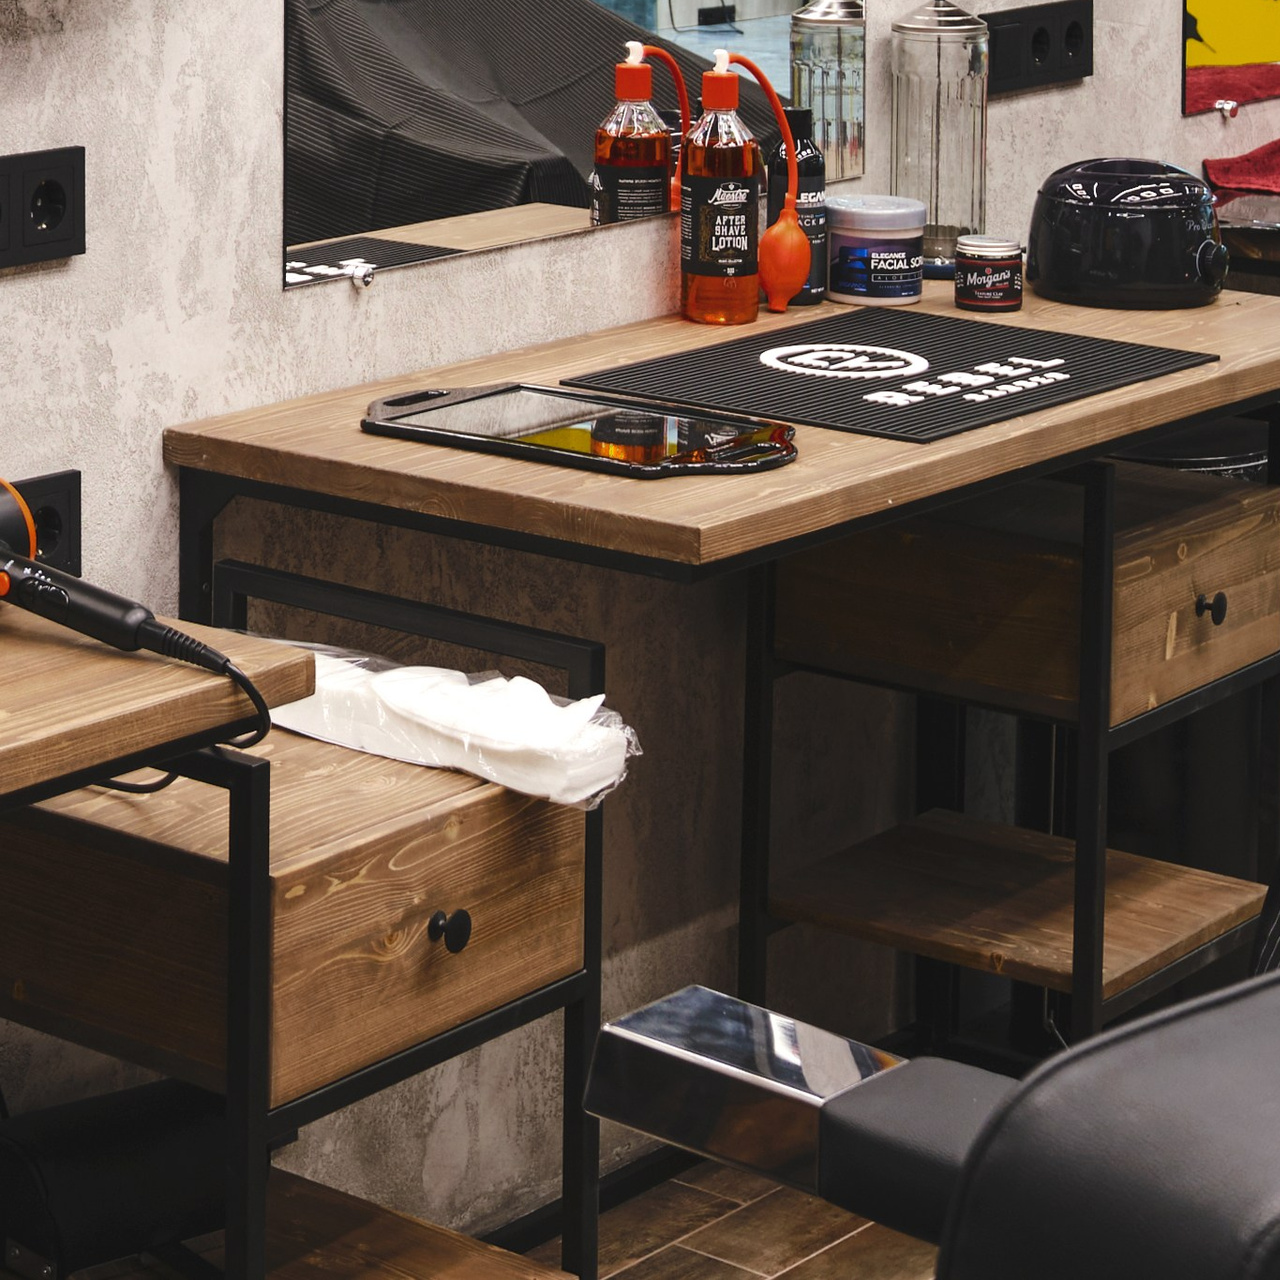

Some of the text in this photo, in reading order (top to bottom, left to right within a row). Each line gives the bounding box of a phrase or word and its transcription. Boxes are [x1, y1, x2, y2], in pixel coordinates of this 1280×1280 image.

[715, 215, 746, 226] AFTER
[714, 225, 746, 236] SHAVE
[712, 236, 748, 251] LOTION
[871, 259, 909, 270] FACIAL
[966, 270, 1011, 289] Morgan's
[863, 356, 1065, 406] REBEL
